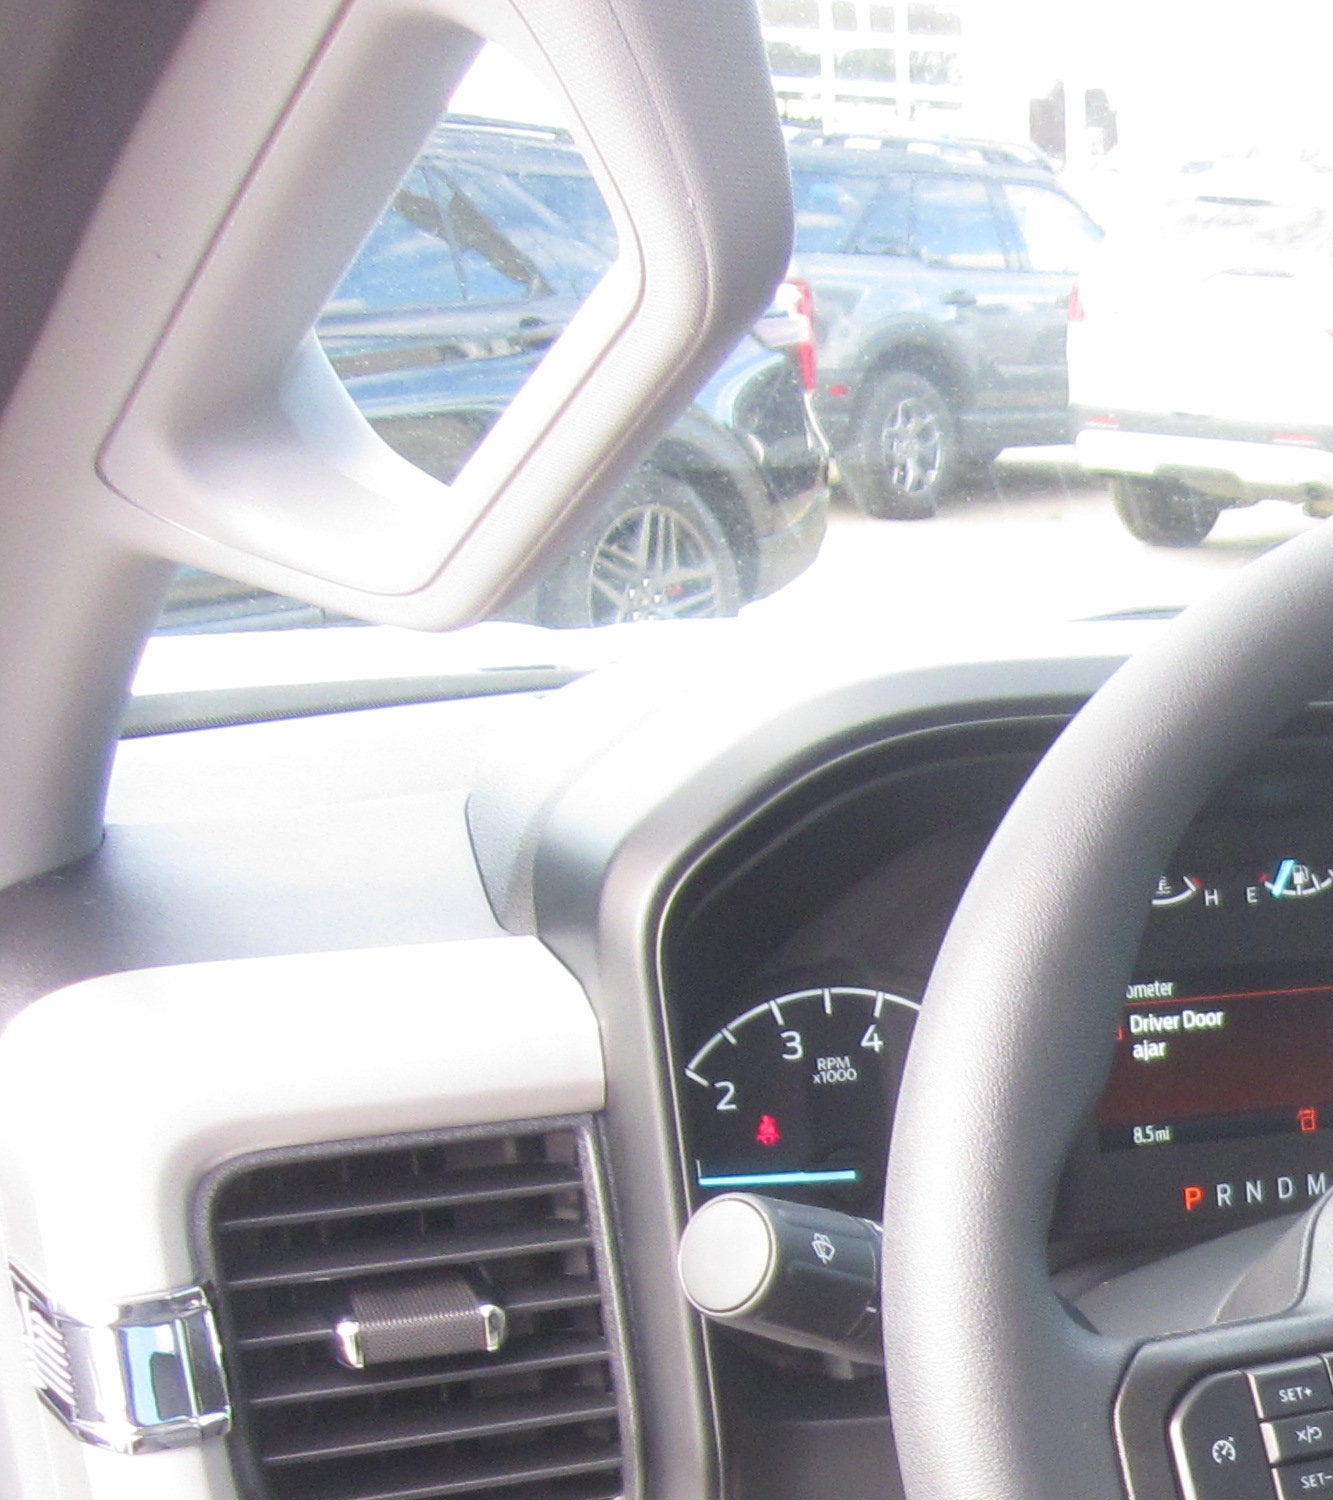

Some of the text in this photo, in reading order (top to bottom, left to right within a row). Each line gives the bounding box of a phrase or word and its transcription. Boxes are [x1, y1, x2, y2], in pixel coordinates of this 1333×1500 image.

[1205, 887, 1220, 907] H
[1246, 885, 1259, 904] E
[1125, 978, 1174, 999] ometer
[1130, 1008, 1225, 1034] Driver Door
[779, 1029, 805, 1061] 3
[859, 1023, 885, 1054] 4
[1132, 1038, 1167, 1061] ajar
[811, 1066, 858, 1084] x1000
[816, 1055, 851, 1072] RPM
[714, 1080, 738, 1111] 2
[1184, 1173, 1328, 1211] P R N D M
